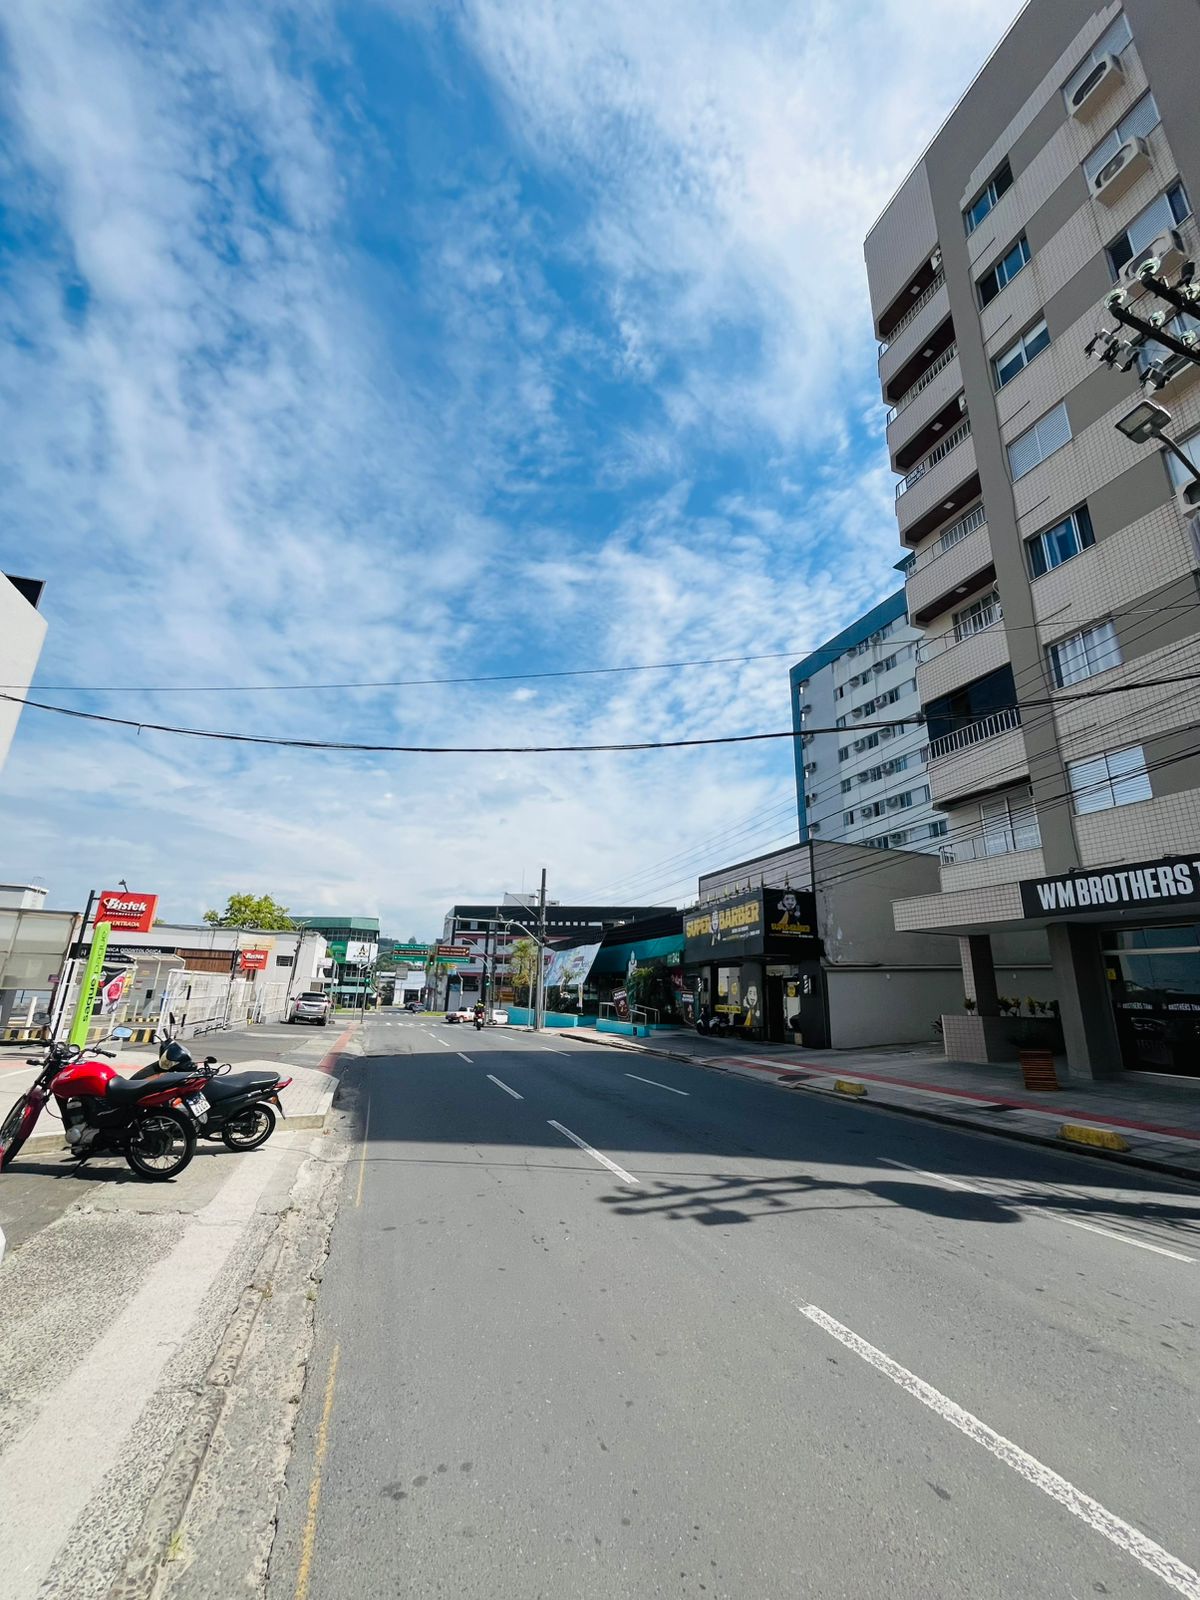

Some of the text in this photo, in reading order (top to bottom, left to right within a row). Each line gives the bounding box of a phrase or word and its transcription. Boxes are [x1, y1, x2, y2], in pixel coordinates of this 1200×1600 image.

[103, 898, 147, 911] Bistek
[1037, 880, 1076, 910] WM
[1075, 863, 1194, 906] BROTHERS
[686, 900, 759, 938] SUPER BARBER
